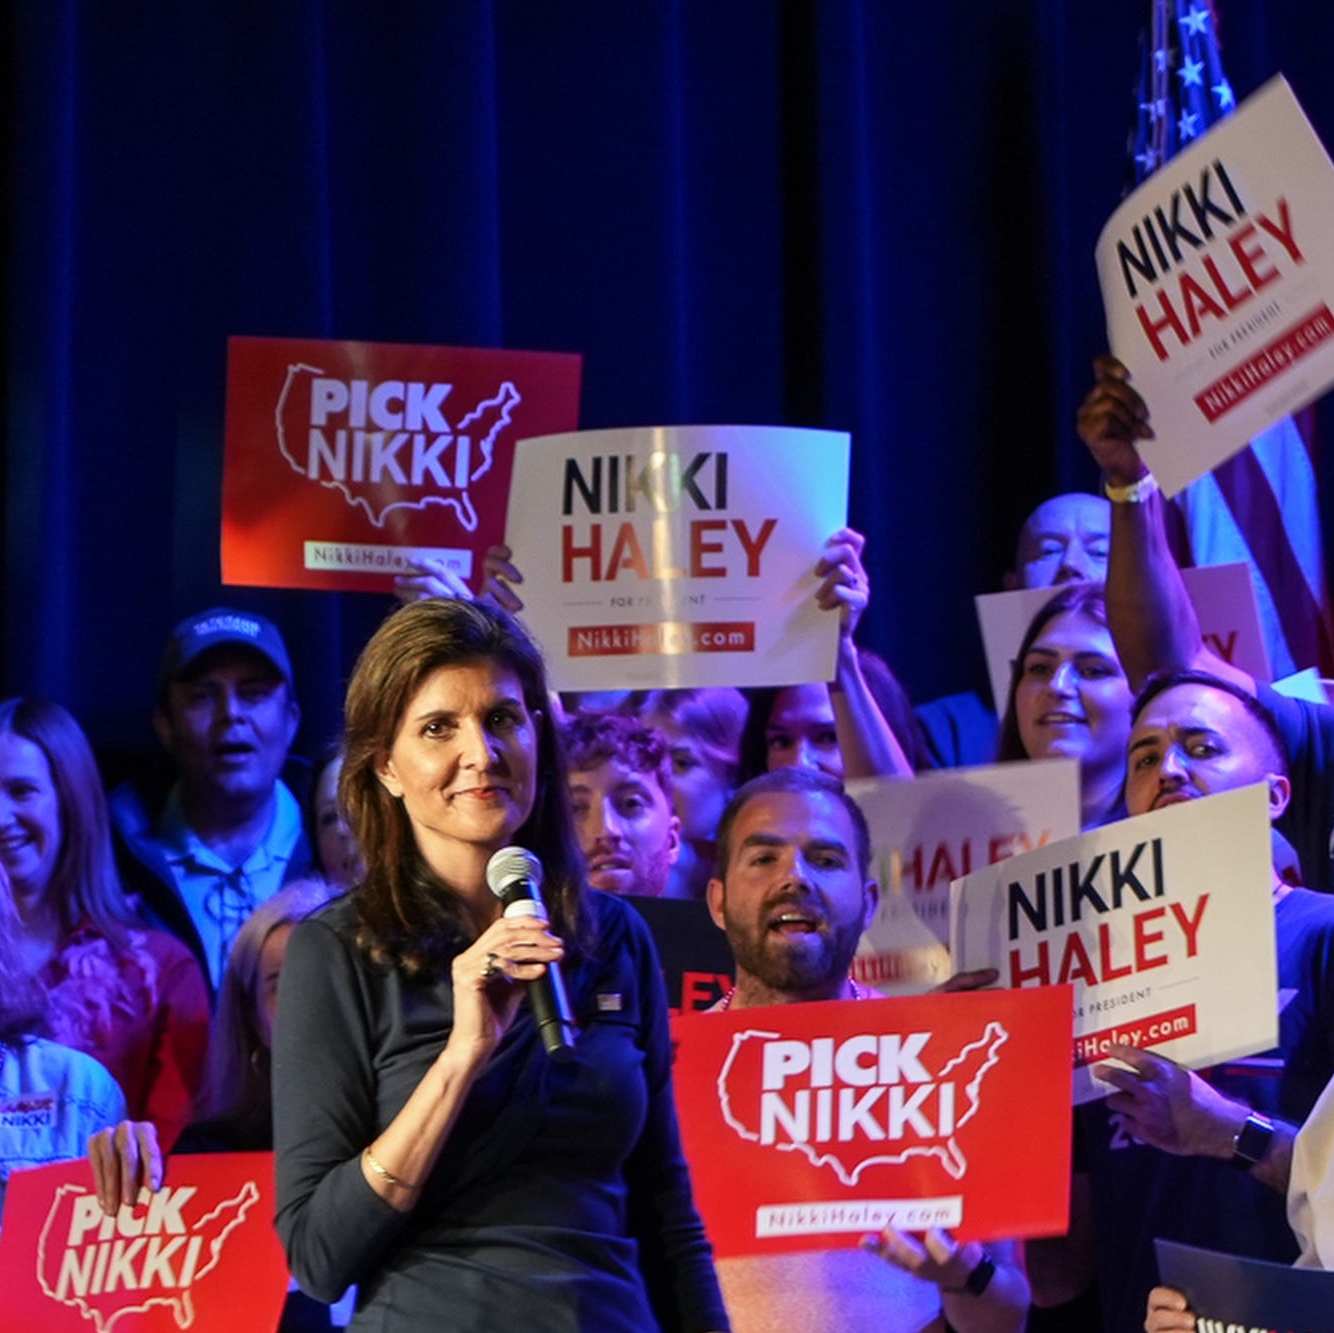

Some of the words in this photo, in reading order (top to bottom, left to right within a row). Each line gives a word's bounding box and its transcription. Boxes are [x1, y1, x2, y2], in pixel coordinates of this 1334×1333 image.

[1117, 159, 1246, 299] NIKKI
[1136, 196, 1305, 362] HALEY
[1203, 315, 1332, 414] NikkiHaley.com
[310, 378, 453, 433] PICK
[307, 428, 471, 489] NIKKI
[563, 452, 728, 515] NIKKI
[563, 518, 778, 582] HALEY
[1009, 838, 1165, 941] NIKKI
[1009, 893, 1211, 989] HALEY
[1088, 987, 1153, 1014] PRESIDENT
[762, 1032, 933, 1090] PICK
[760, 1081, 956, 1146] NIKKI
[68, 1186, 198, 1247] PICK
[55, 1235, 204, 1301] NIKKI
